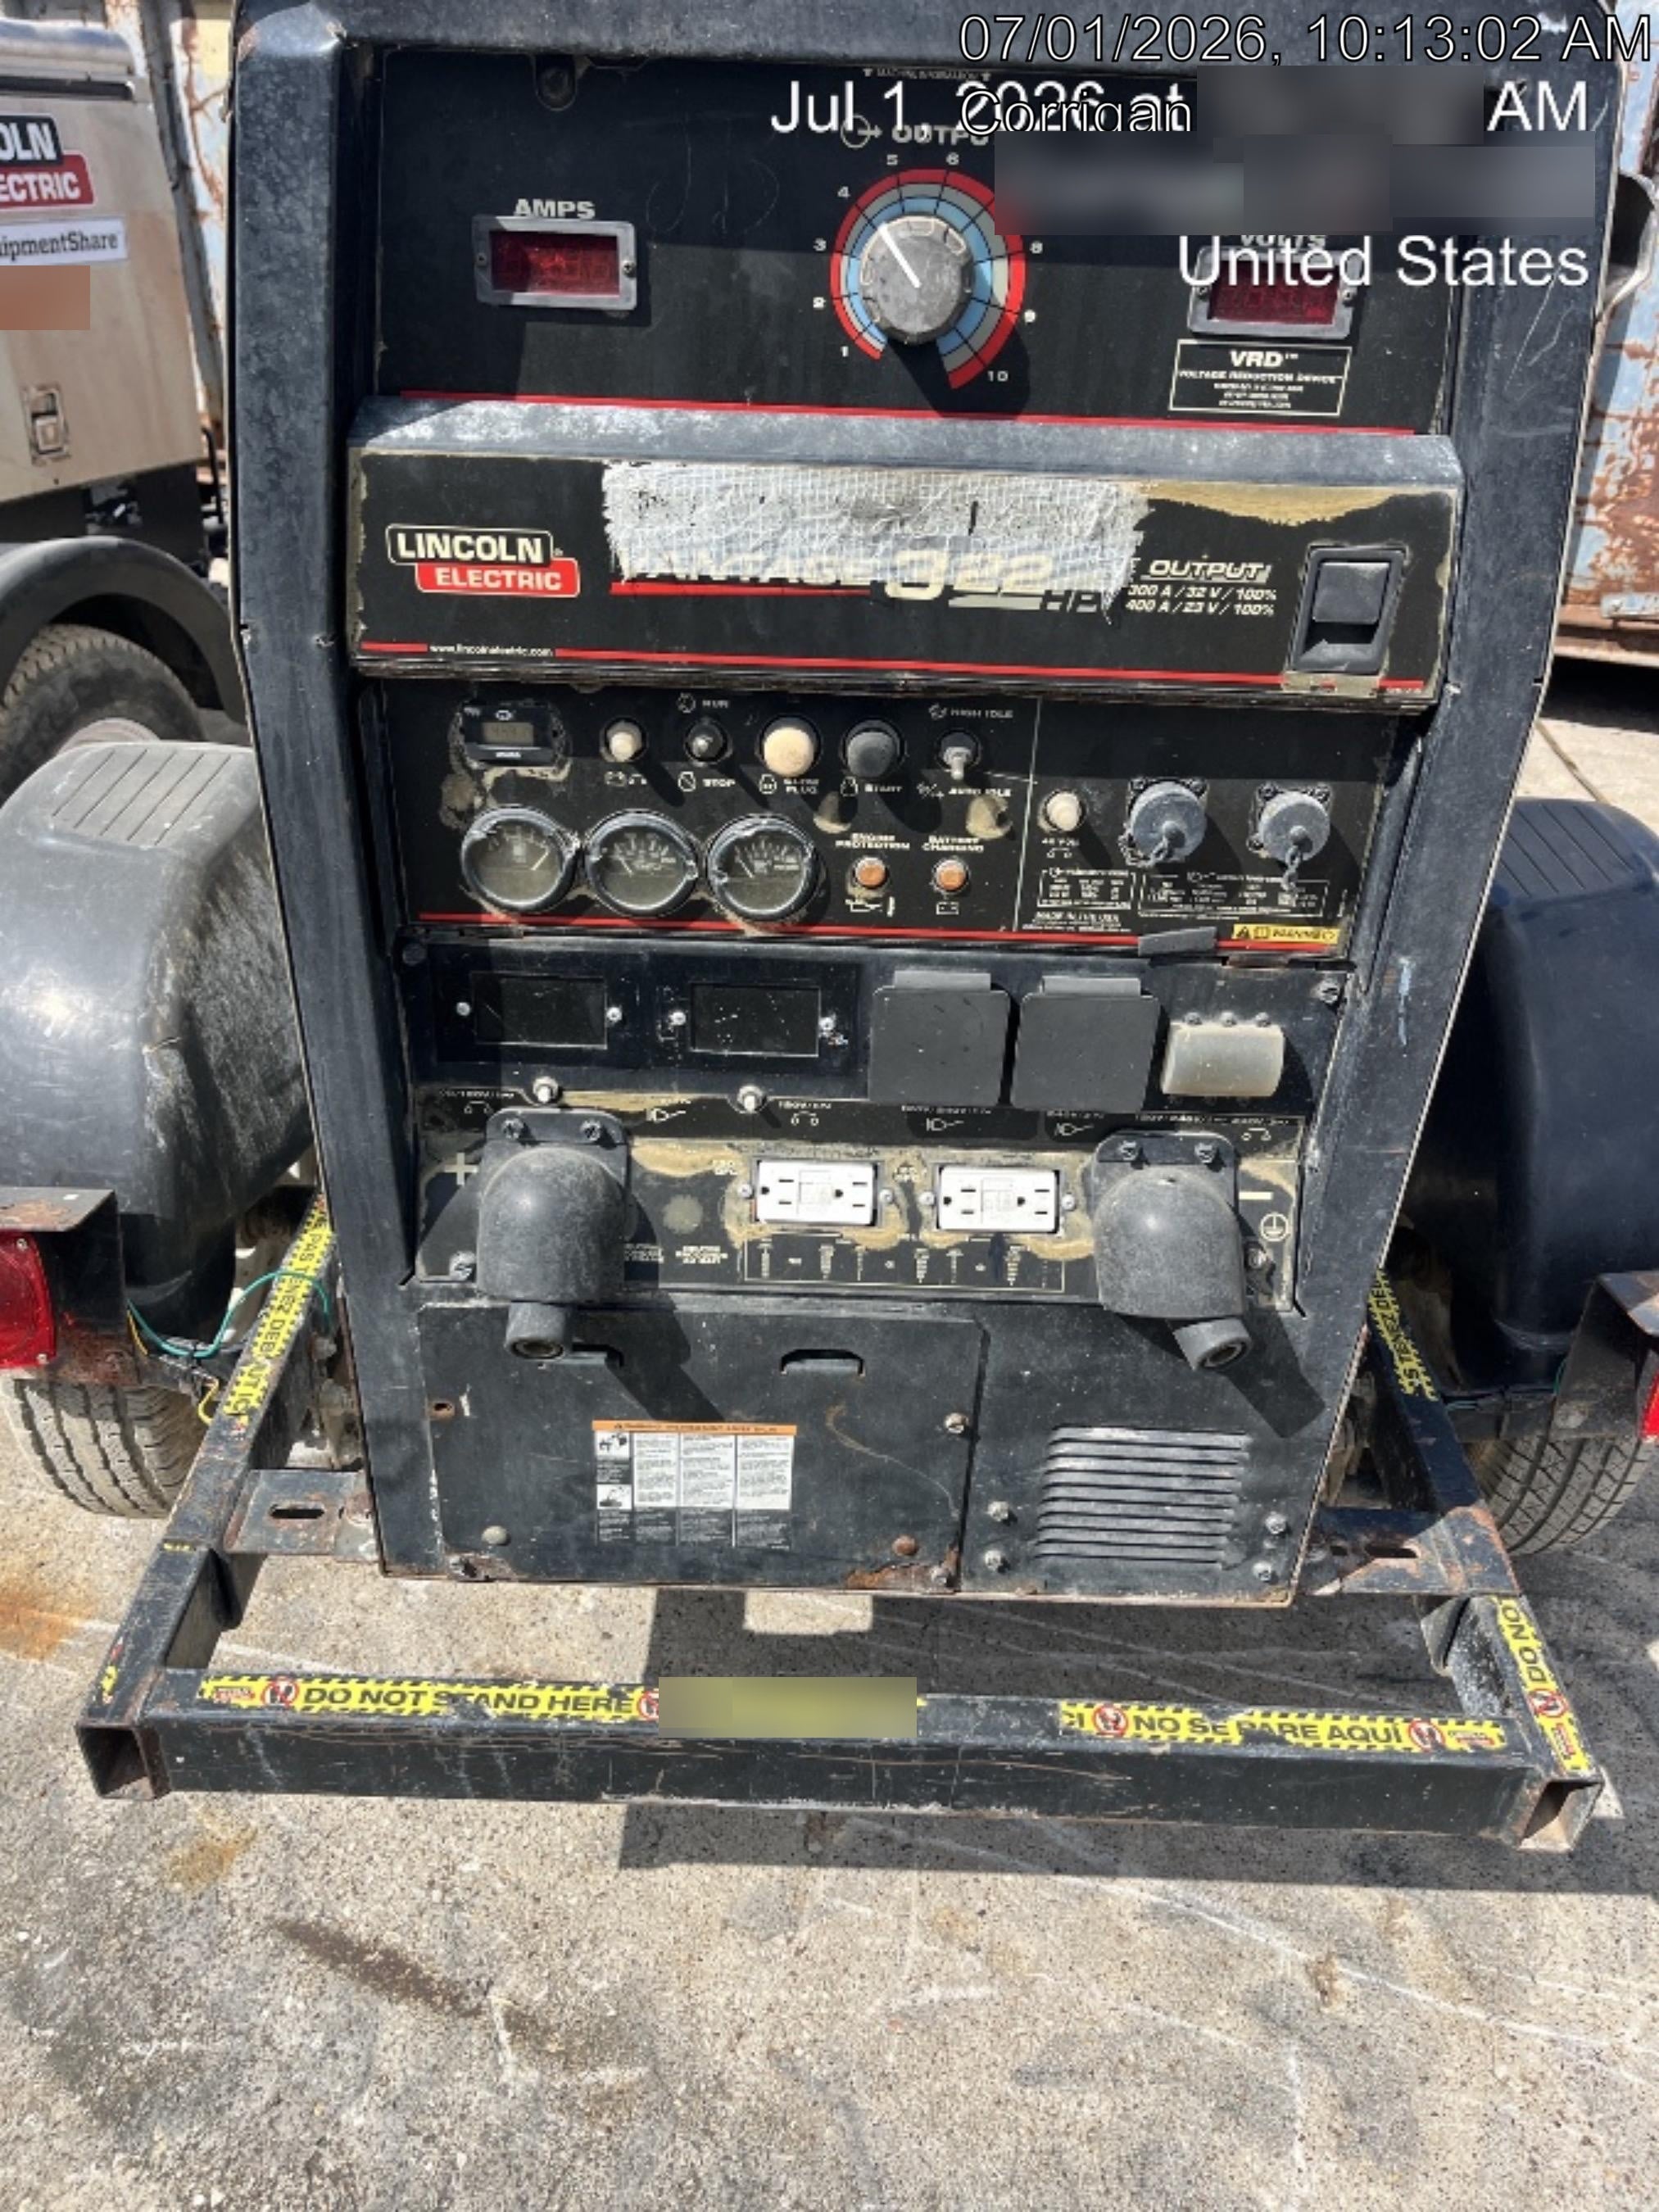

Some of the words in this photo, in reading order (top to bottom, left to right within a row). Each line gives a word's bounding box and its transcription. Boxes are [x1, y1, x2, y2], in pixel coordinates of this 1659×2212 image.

[891, 124, 990, 145] OUTPU
[886, 154, 898, 165] 5
[946, 153, 959, 165] 6
[837, 186, 850, 198] 4
[514, 198, 596, 220] AMPS
[814, 238, 827, 252] 3
[841, 347, 848, 357] 1
[988, 371, 1009, 382] 10
[397, 533, 544, 564] LINCOLN
[435, 567, 562, 591] ELECTRIC
[1149, 560, 1264, 580] OUTPUT
[304, 1688, 351, 1704] DO
[359, 1689, 427, 1706] NOT
[547, 1695, 633, 1714] HERE
[1133, 1715, 1181, 1734] NO
